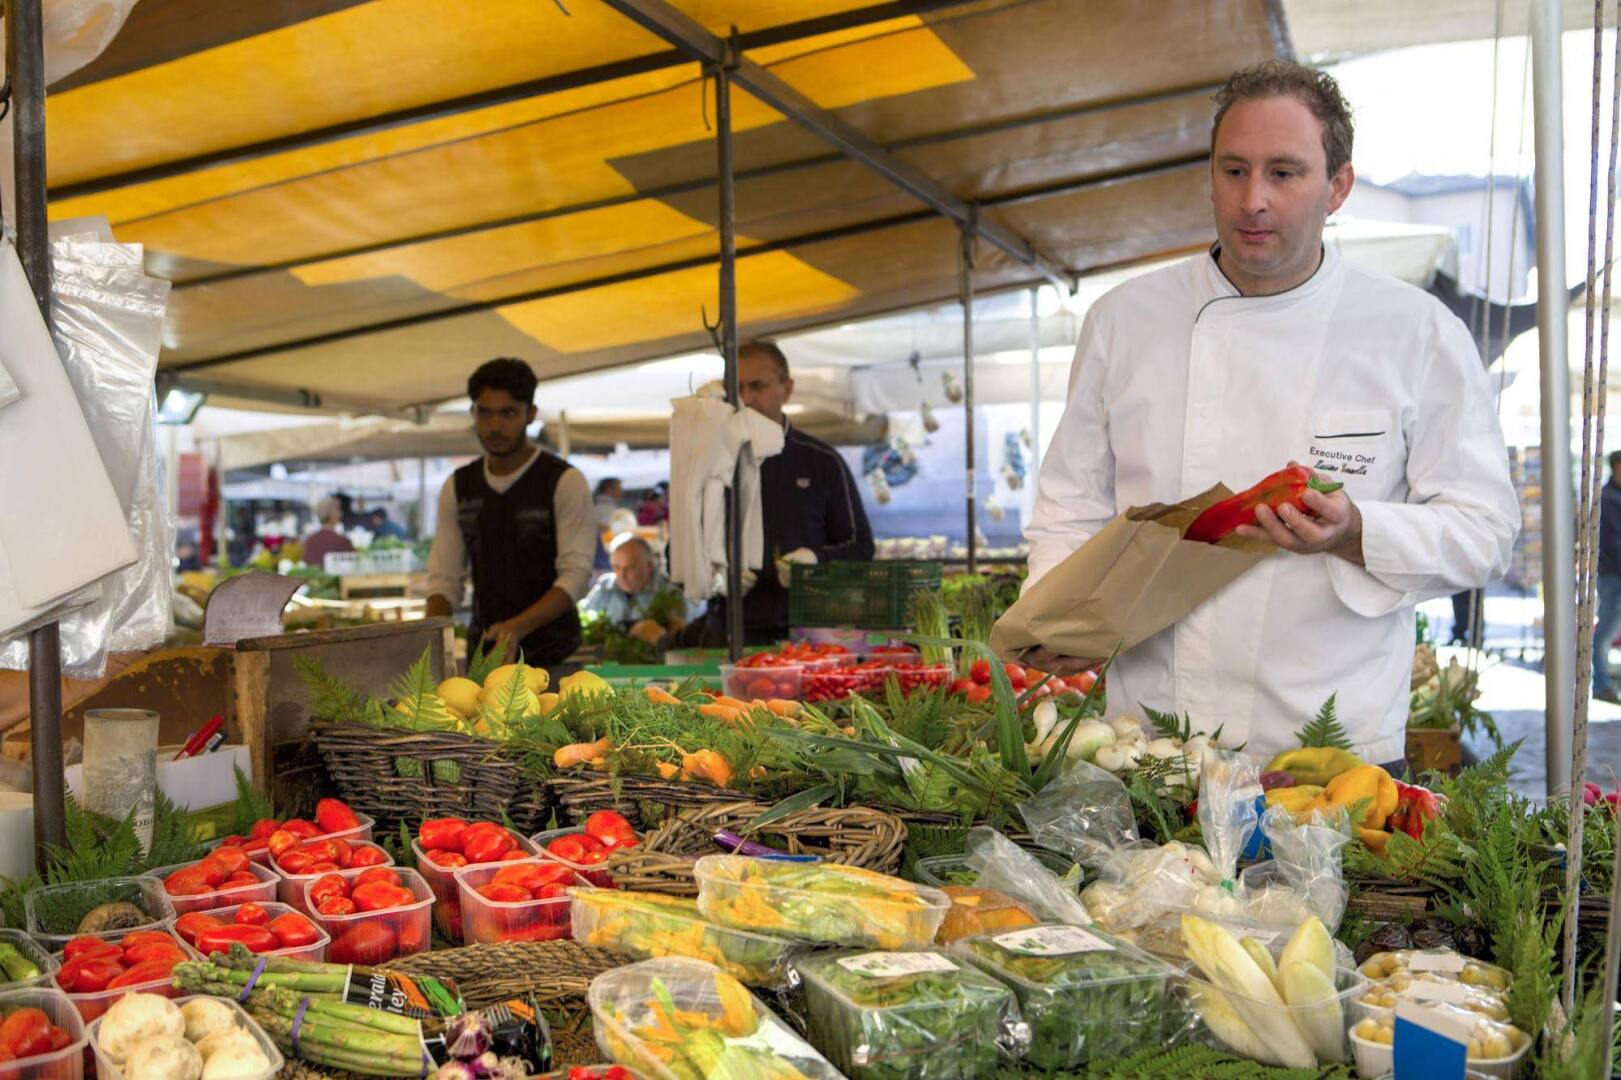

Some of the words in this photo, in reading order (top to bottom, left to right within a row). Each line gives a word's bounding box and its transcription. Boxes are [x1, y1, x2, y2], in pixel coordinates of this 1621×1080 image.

[1309, 446, 1353, 461] Executive
[1355, 454, 1376, 465] Chef
[368, 974, 387, 1009] erald
[386, 987, 408, 1014] ley
